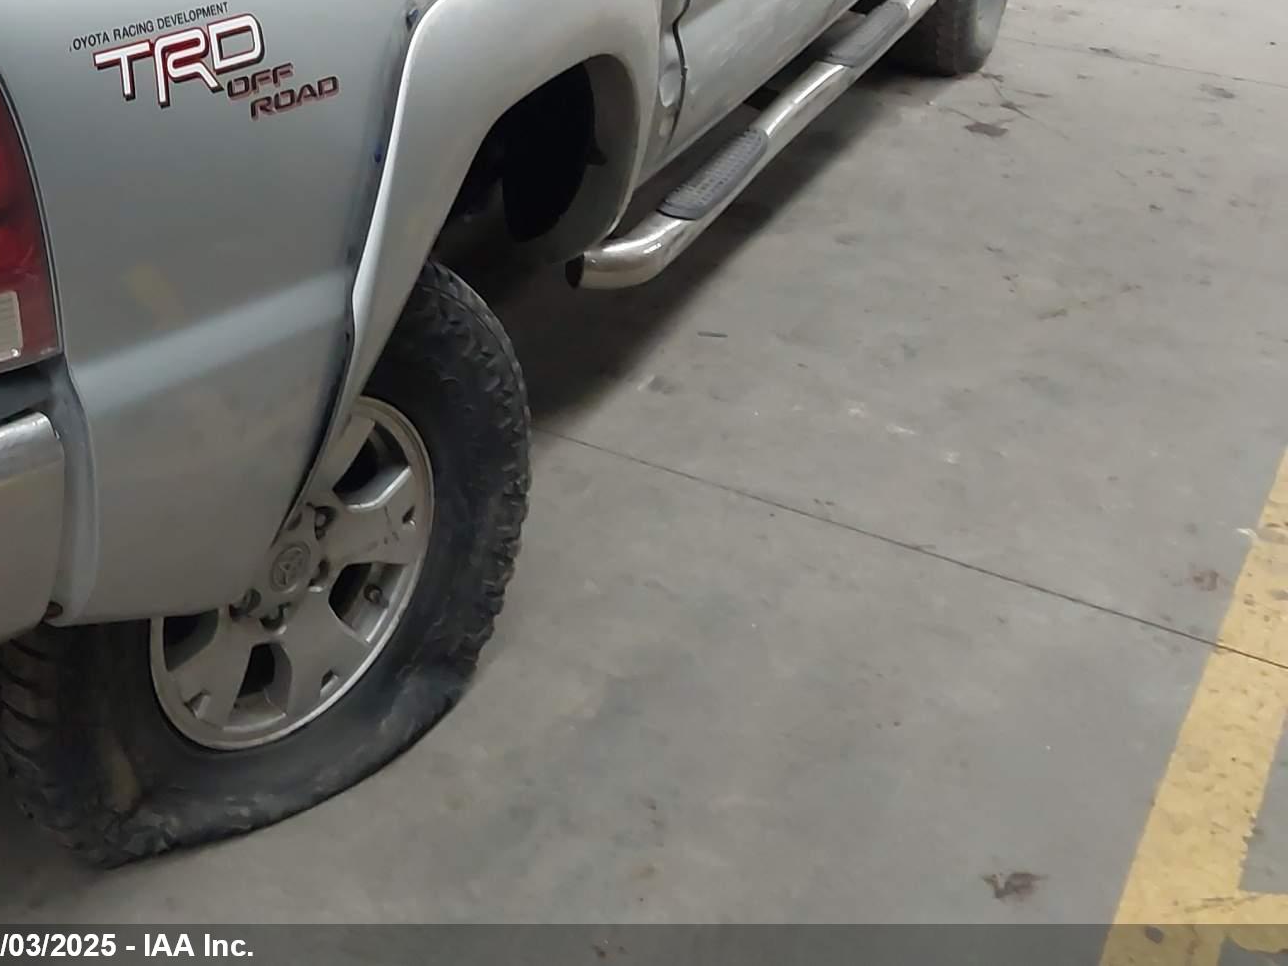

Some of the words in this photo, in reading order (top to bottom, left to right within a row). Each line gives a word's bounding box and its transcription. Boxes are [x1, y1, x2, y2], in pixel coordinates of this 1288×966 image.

[69, 31, 111, 52] OYOTA
[112, 19, 155, 41] RACING
[156, 1, 229, 30] DEVELOPMENT
[92, 12, 265, 109] TRD
[227, 62, 294, 99] OFF
[250, 74, 340, 121] ROAD
